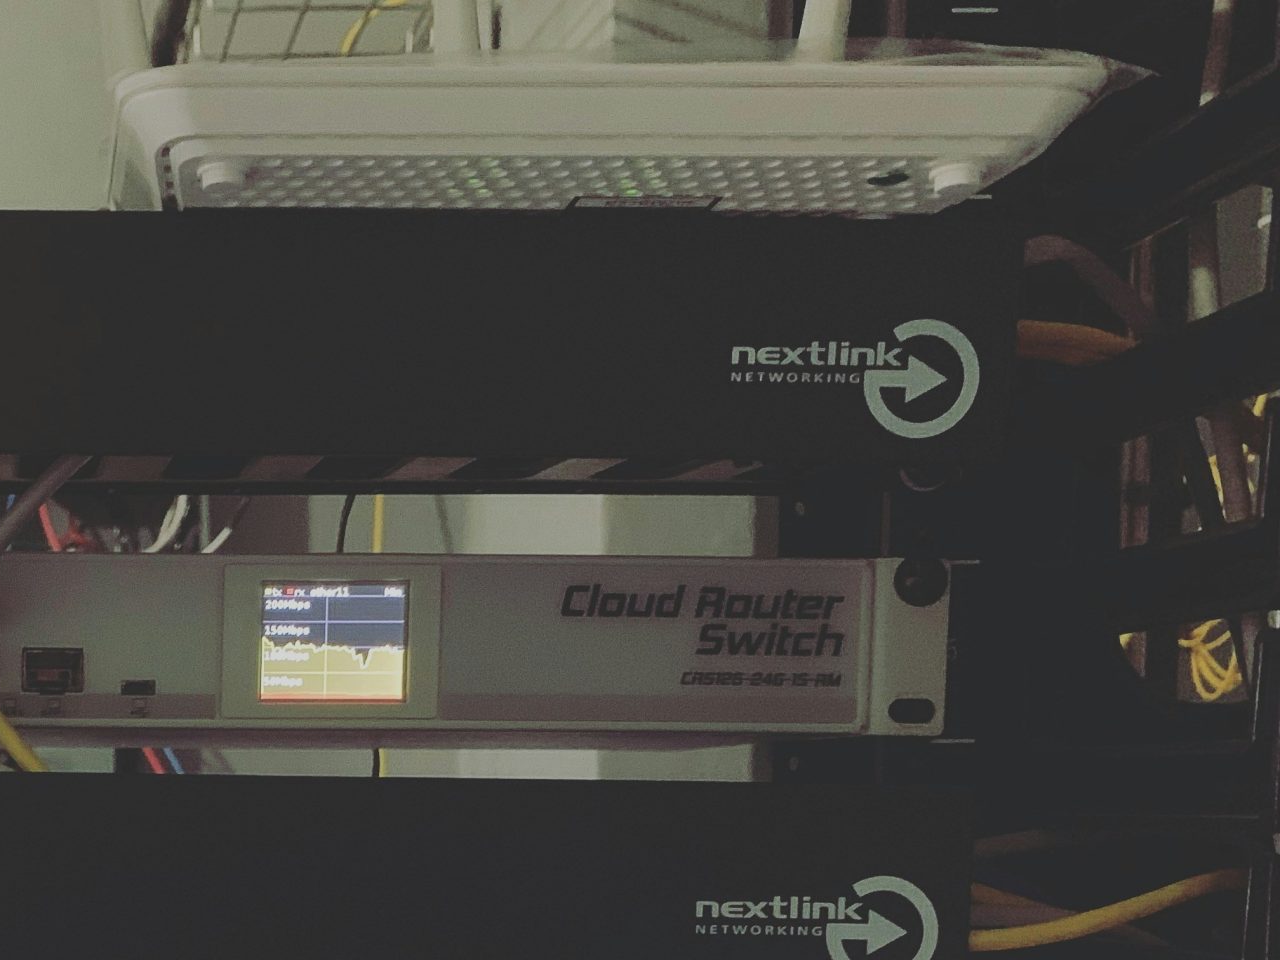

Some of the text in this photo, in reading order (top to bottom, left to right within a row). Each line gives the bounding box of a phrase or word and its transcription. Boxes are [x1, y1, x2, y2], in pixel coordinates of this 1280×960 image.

[731, 341, 902, 366] nextlink
[730, 371, 860, 384] NETWORKING
[561, 584, 845, 619] Cloud Router
[695, 623, 845, 657] Switch
[695, 896, 863, 920] nextlink
[695, 924, 823, 936] NETWORKING
